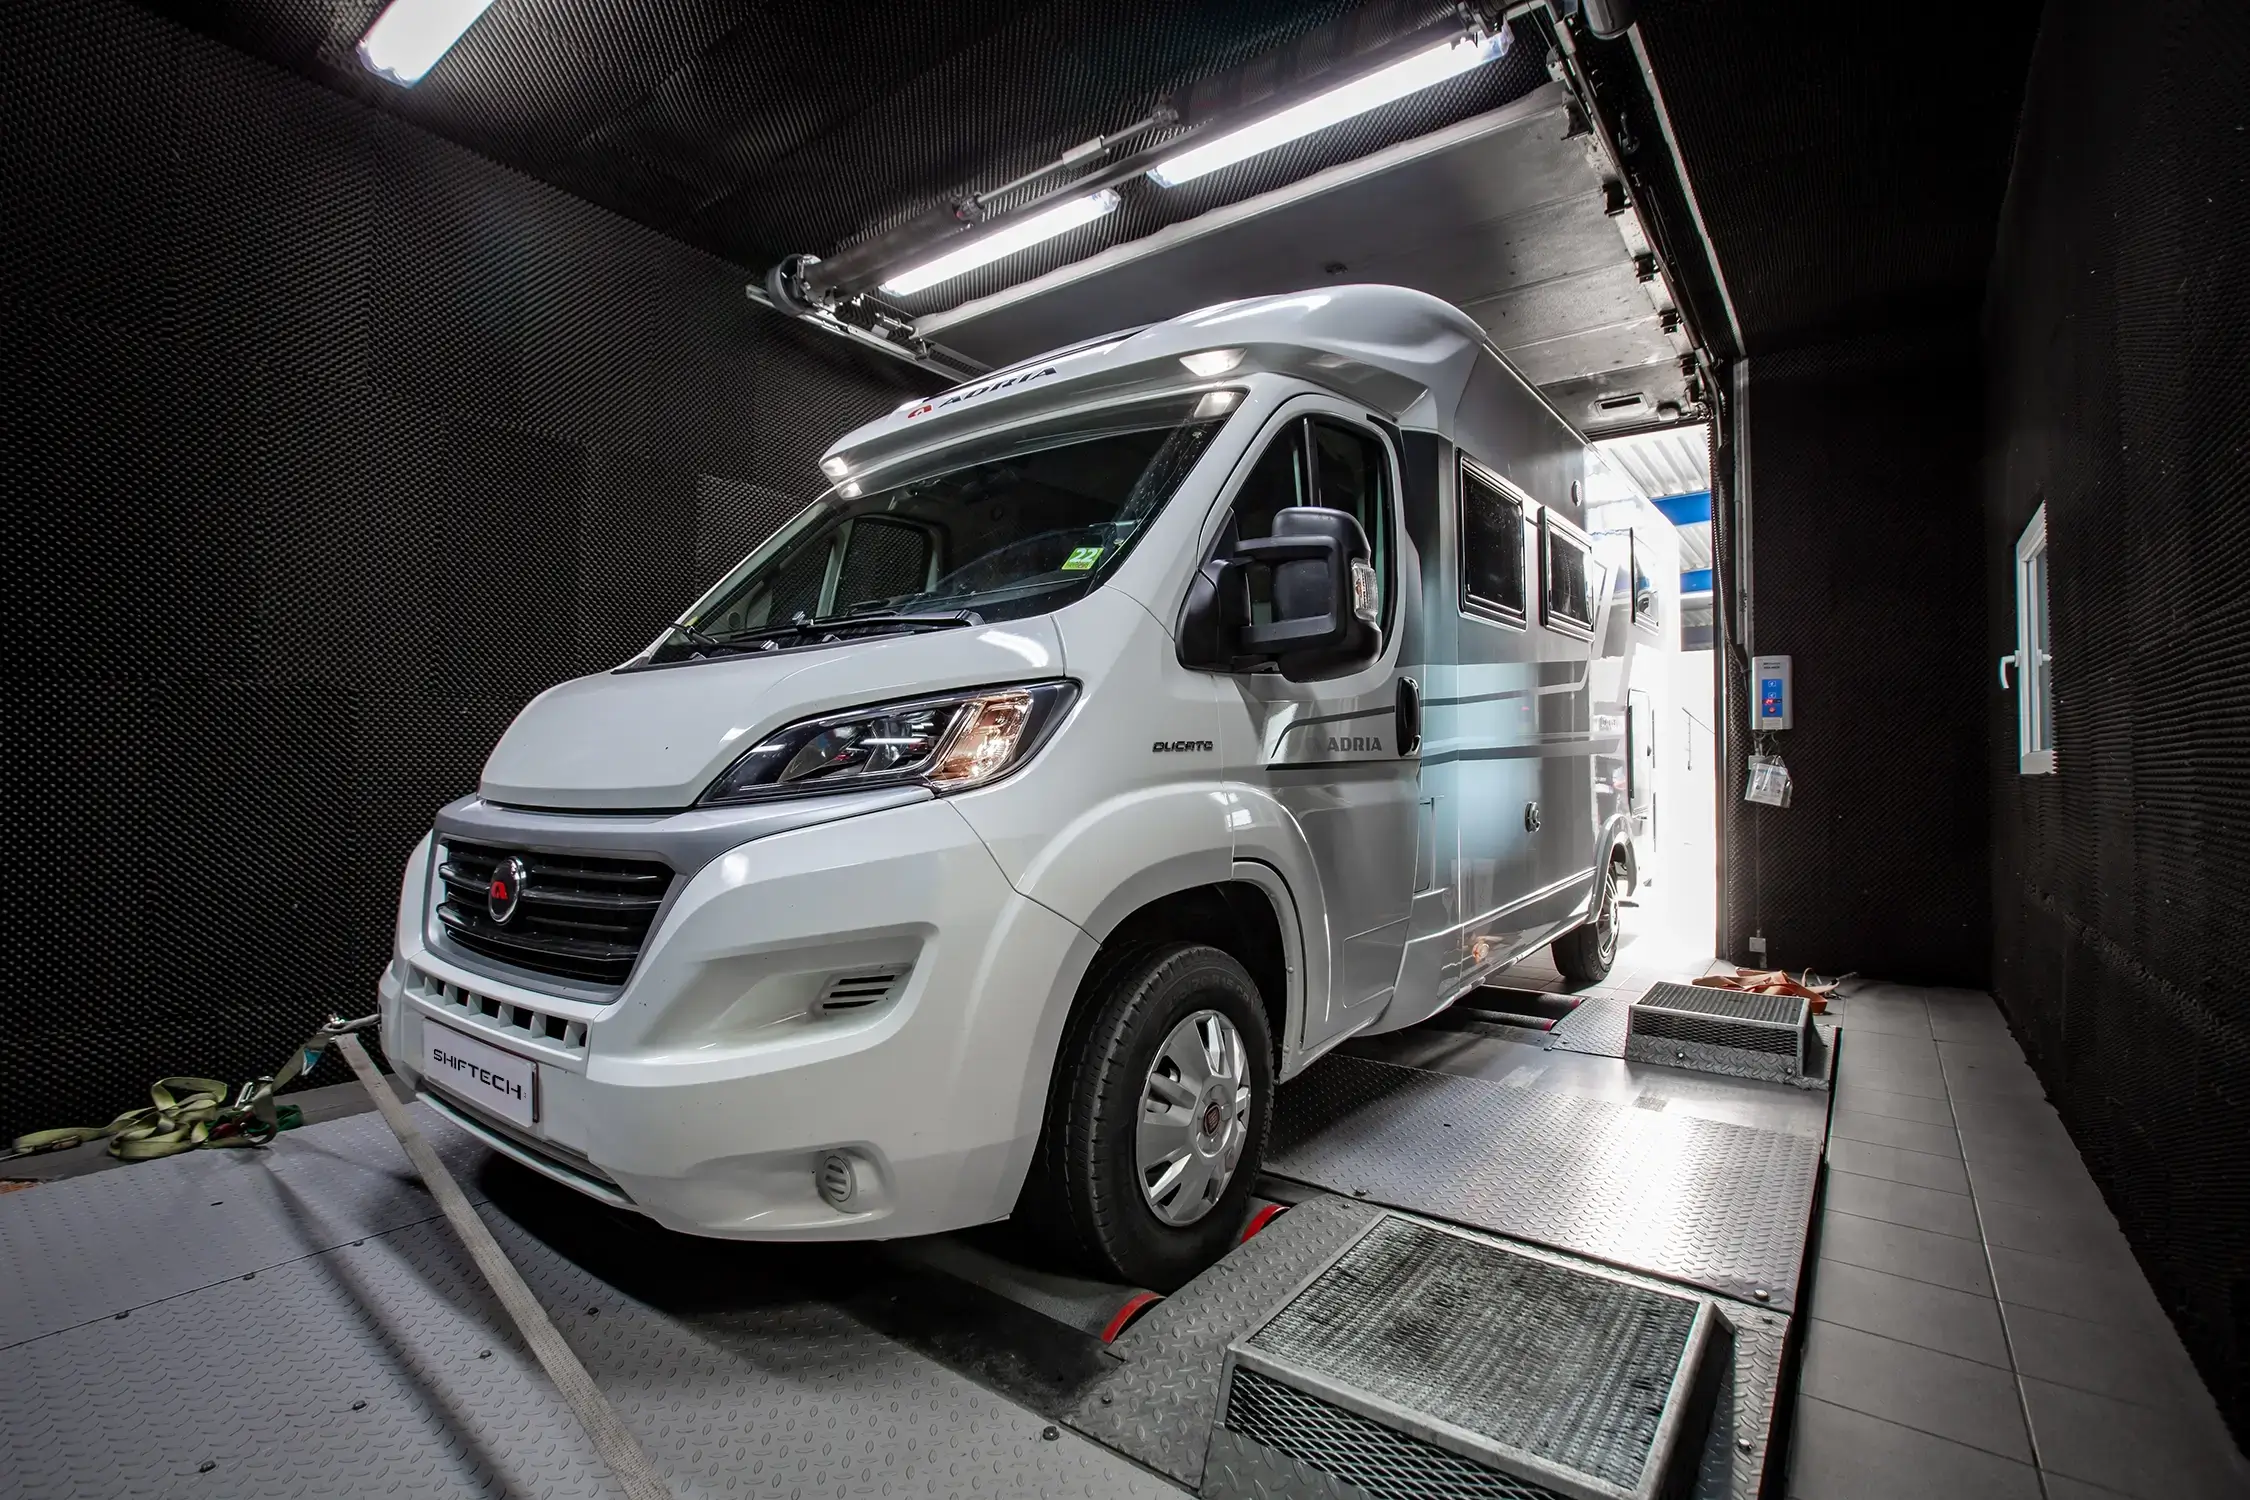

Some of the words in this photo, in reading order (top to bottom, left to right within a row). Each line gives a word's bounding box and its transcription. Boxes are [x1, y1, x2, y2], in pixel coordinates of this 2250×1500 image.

[938, 366, 1057, 408] ADRIA
[1069, 547, 1098, 562] 22
[1152, 740, 1214, 753] DUCATO
[1327, 736, 1383, 752] ADRIA
[433, 1048, 522, 1101] SHIFTECH
